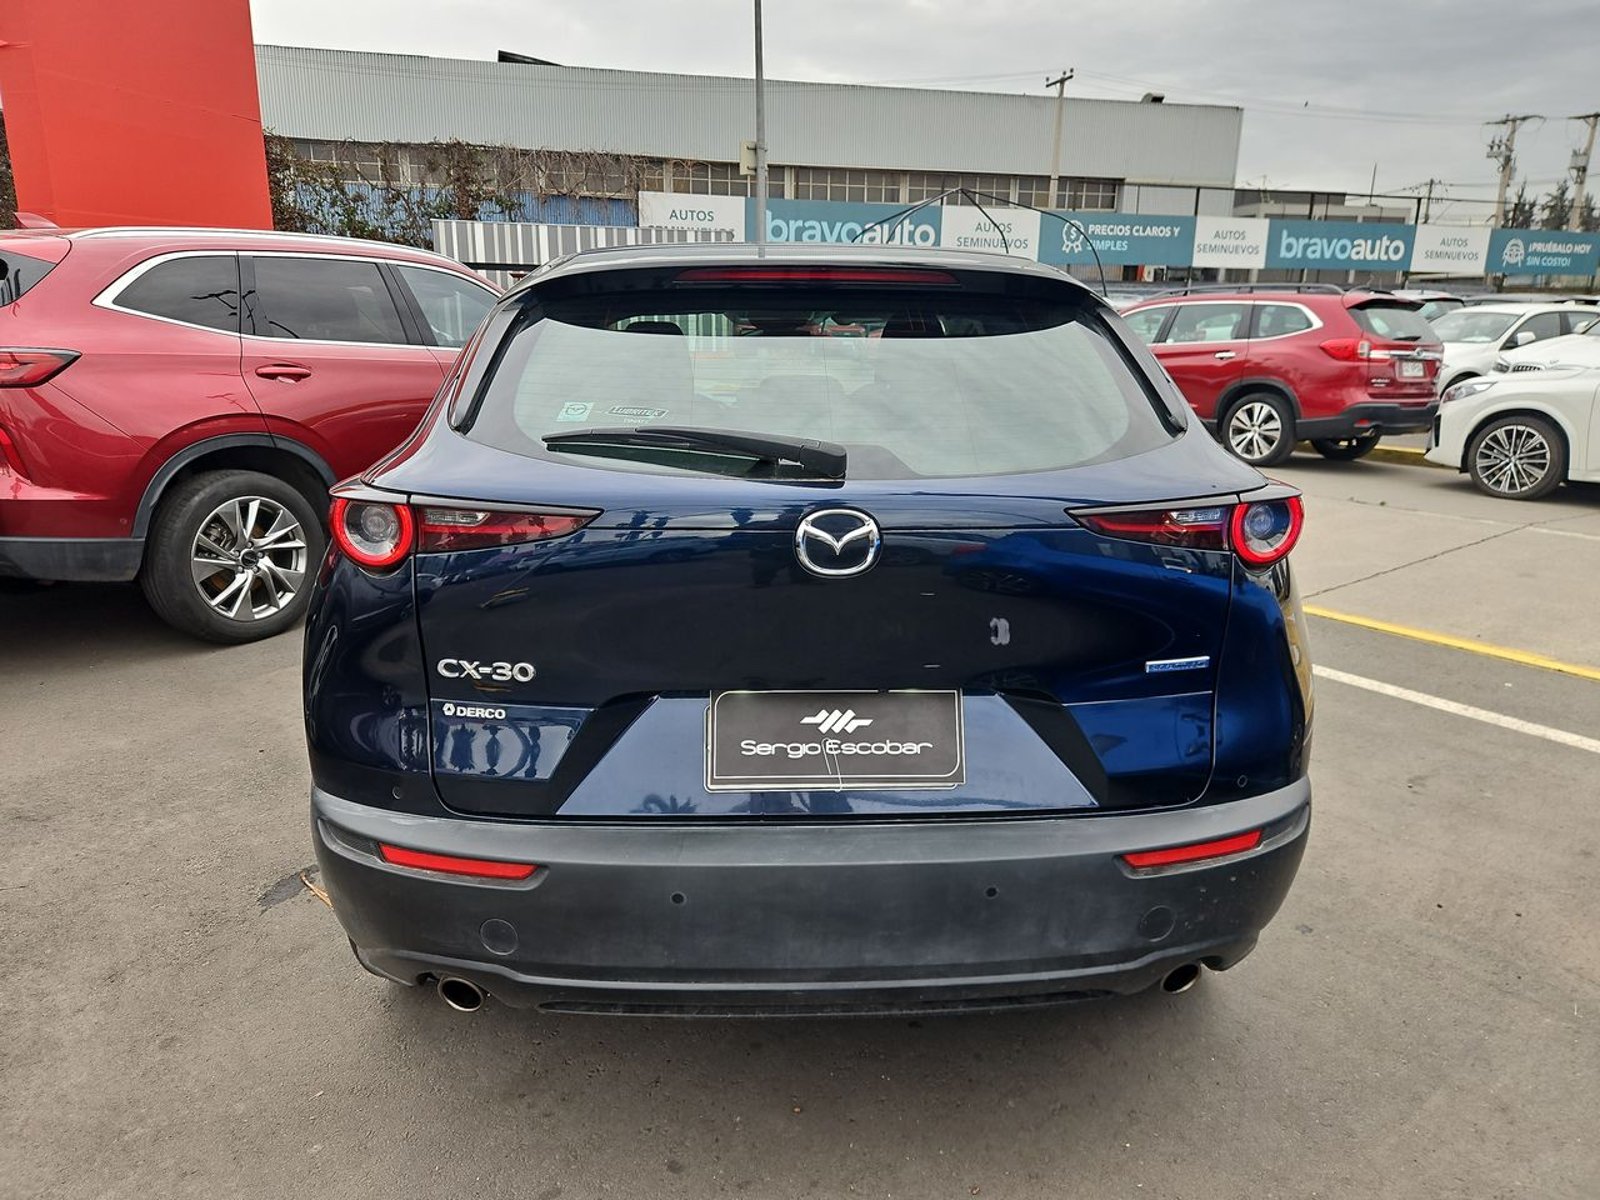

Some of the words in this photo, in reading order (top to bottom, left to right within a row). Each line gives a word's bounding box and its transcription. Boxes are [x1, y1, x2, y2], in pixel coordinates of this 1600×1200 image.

[669, 209, 715, 222] AUTOS
[766, 209, 936, 247] bravoauto
[975, 222, 1012, 233] AUTOS
[1088, 224, 1130, 237] PRECIOS
[1132, 226, 1171, 238] CLAROS
[1173, 226, 1181, 238] Y
[1213, 230, 1246, 241] AUTOS
[1280, 229, 1406, 262] bravoauto
[1440, 237, 1468, 248] AUTOS
[1197, 243, 1260, 255] SEMINUEVOS
[1424, 249, 1479, 261] SEMINUEVOS
[1573, 243, 1592, 255] HOY
[1526, 256, 1540, 266] SIN
[1541, 256, 1571, 267] COSTO!
[436, 658, 537, 682] CX-30
[456, 706, 507, 719] DERCO
[740, 739, 821, 759] Sergio
[825, 739, 934, 756] Escobar
